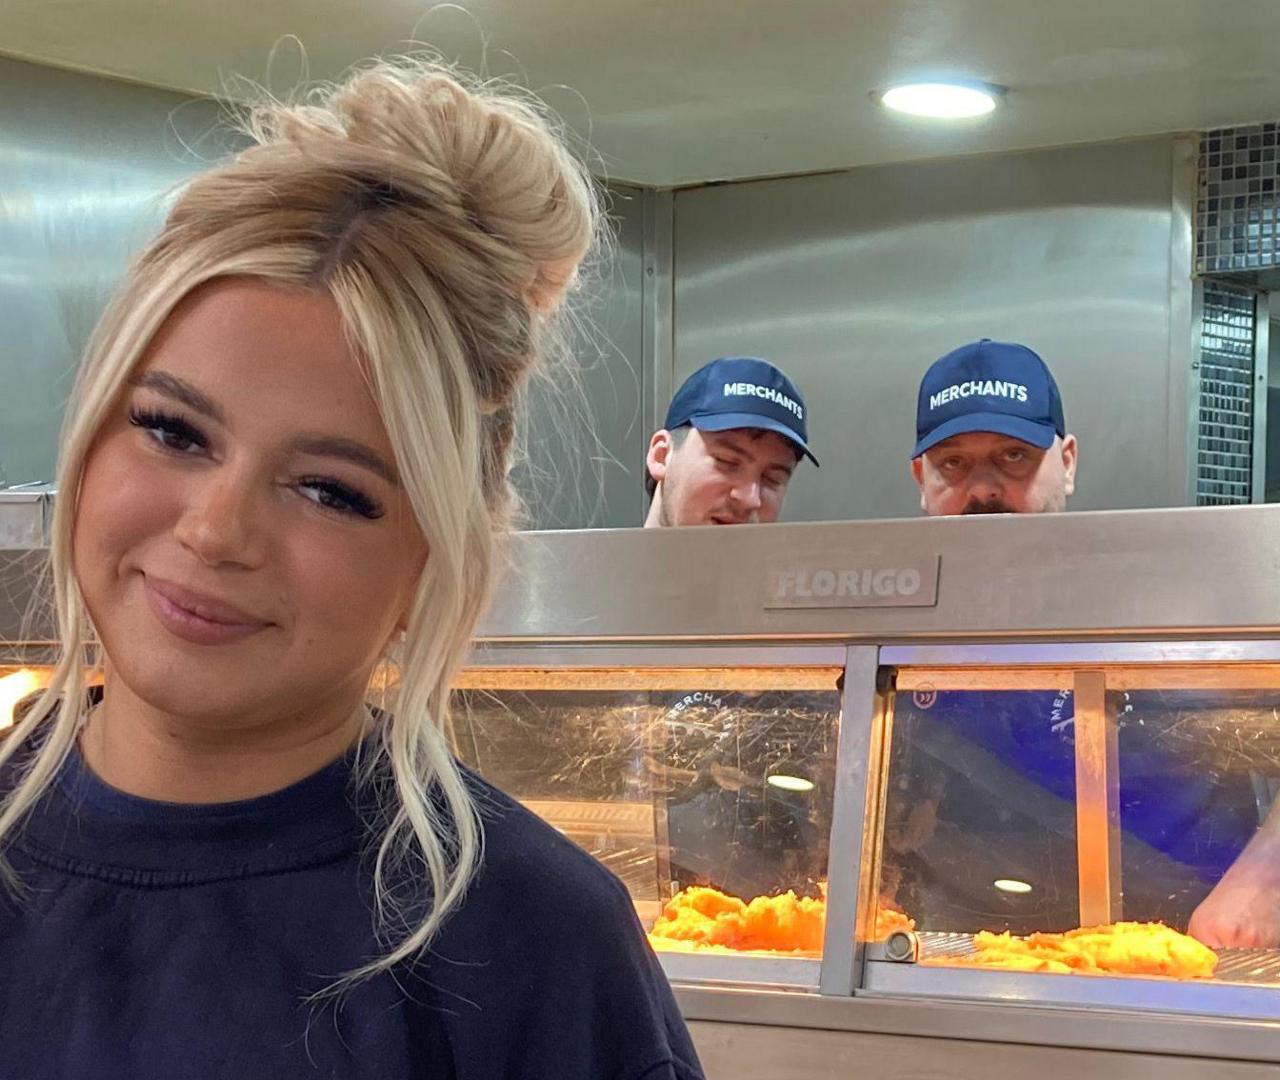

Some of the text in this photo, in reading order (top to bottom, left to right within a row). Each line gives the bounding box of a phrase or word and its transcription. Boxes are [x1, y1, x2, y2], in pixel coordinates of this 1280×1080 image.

[723, 382, 803, 420] MERCHANTS
[929, 380, 1028, 410] MERCHANTS
[776, 568, 921, 598] FLORIGO
